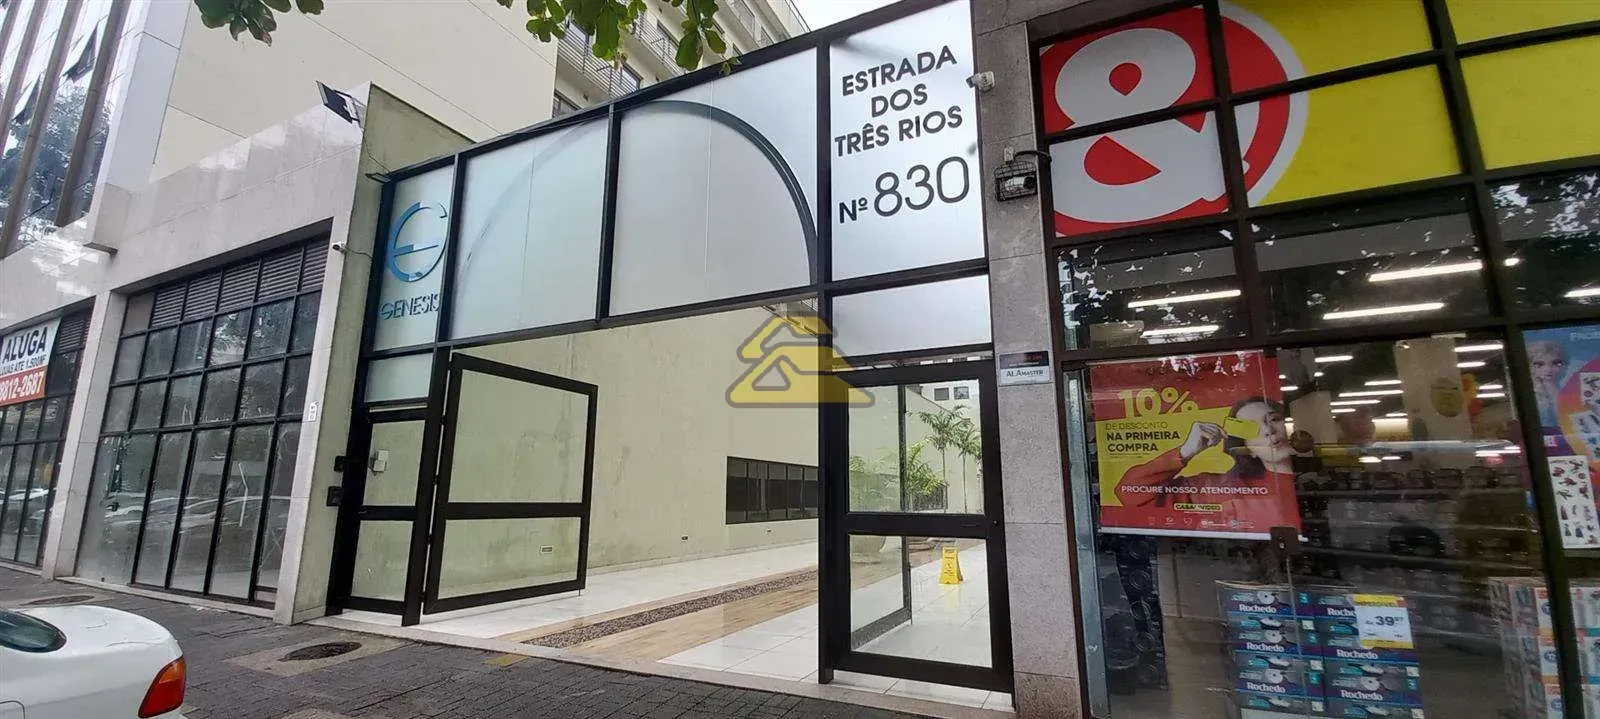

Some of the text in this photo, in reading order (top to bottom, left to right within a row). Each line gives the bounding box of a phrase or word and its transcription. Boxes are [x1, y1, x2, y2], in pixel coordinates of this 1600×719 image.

[842, 45, 957, 97] ESTRADA
[871, 83, 928, 118] DOS
[834, 105, 963, 157] TRÊS RIOS
[873, 156, 970, 217] 830
[3, 326, 48, 363] ALUGA
[1119, 386, 1199, 420] 10%
[1118, 421, 1168, 430] DESCONTO
[1107, 430, 1180, 441] NA PRIMEIRA
[1107, 442, 1158, 452] COMPRA
[1121, 485, 1268, 495] PROCURE NOSSO ATENDIMENTO
[1240, 603, 1277, 614] Rochedo
[1246, 641, 1285, 653] Rochedo
[1336, 649, 1378, 660] Rochedo
[1246, 681, 1286, 693] Rochedo
[1340, 689, 1383, 701] Rochedo
